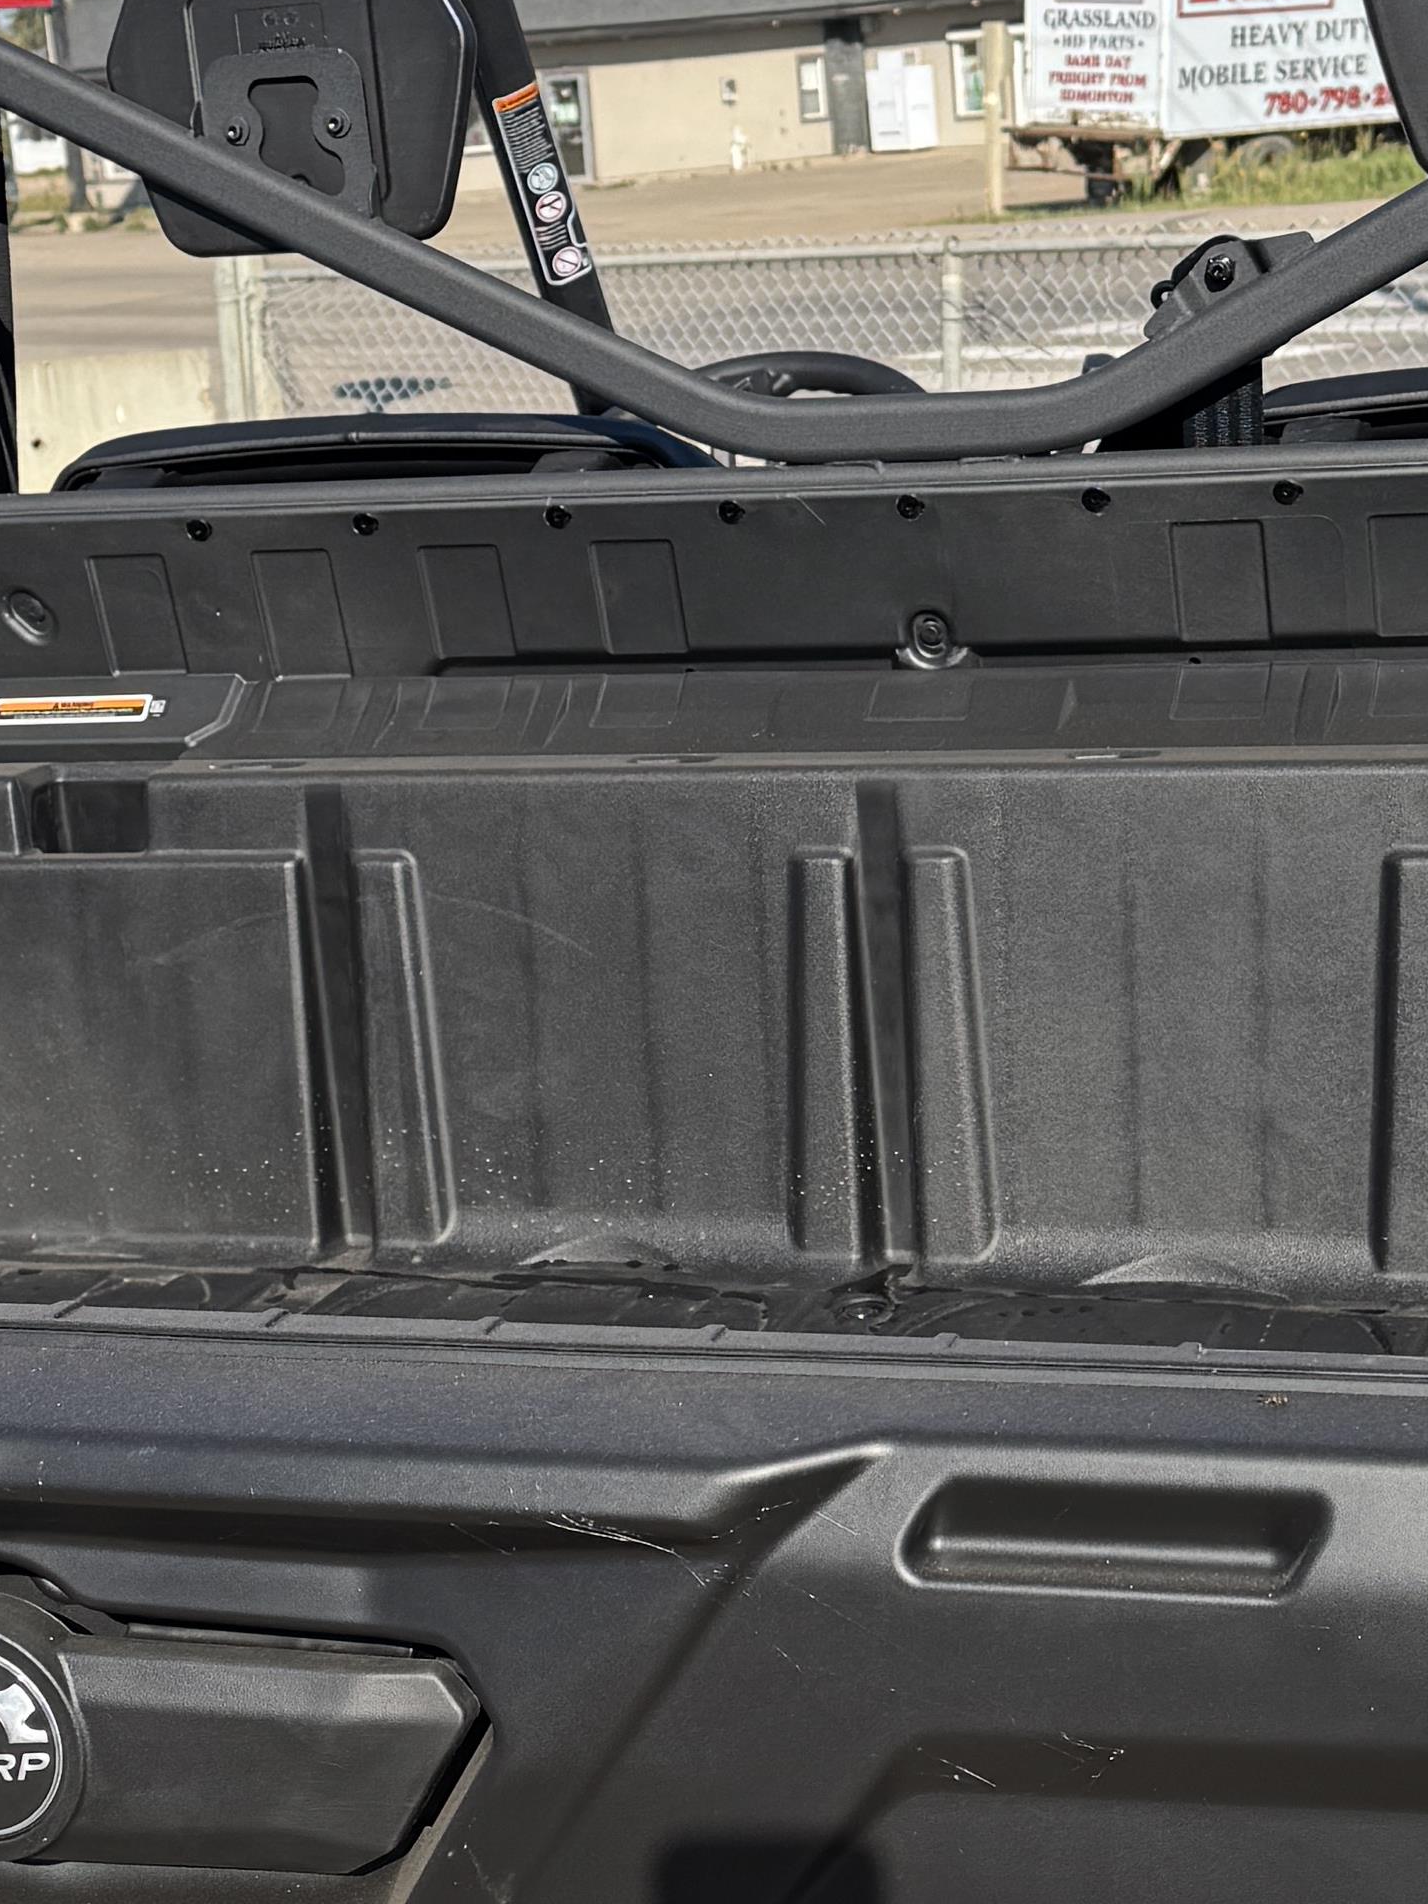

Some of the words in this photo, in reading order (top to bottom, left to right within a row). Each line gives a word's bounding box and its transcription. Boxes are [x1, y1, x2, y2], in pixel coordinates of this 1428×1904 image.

[1043, 8, 1157, 31] GRASSLAND
[1089, 34, 1135, 50] PARTS
[1230, 20, 1308, 48] HEAVY
[1178, 61, 1267, 93] MOBILE
[1273, 54, 1367, 83] SERVICE
